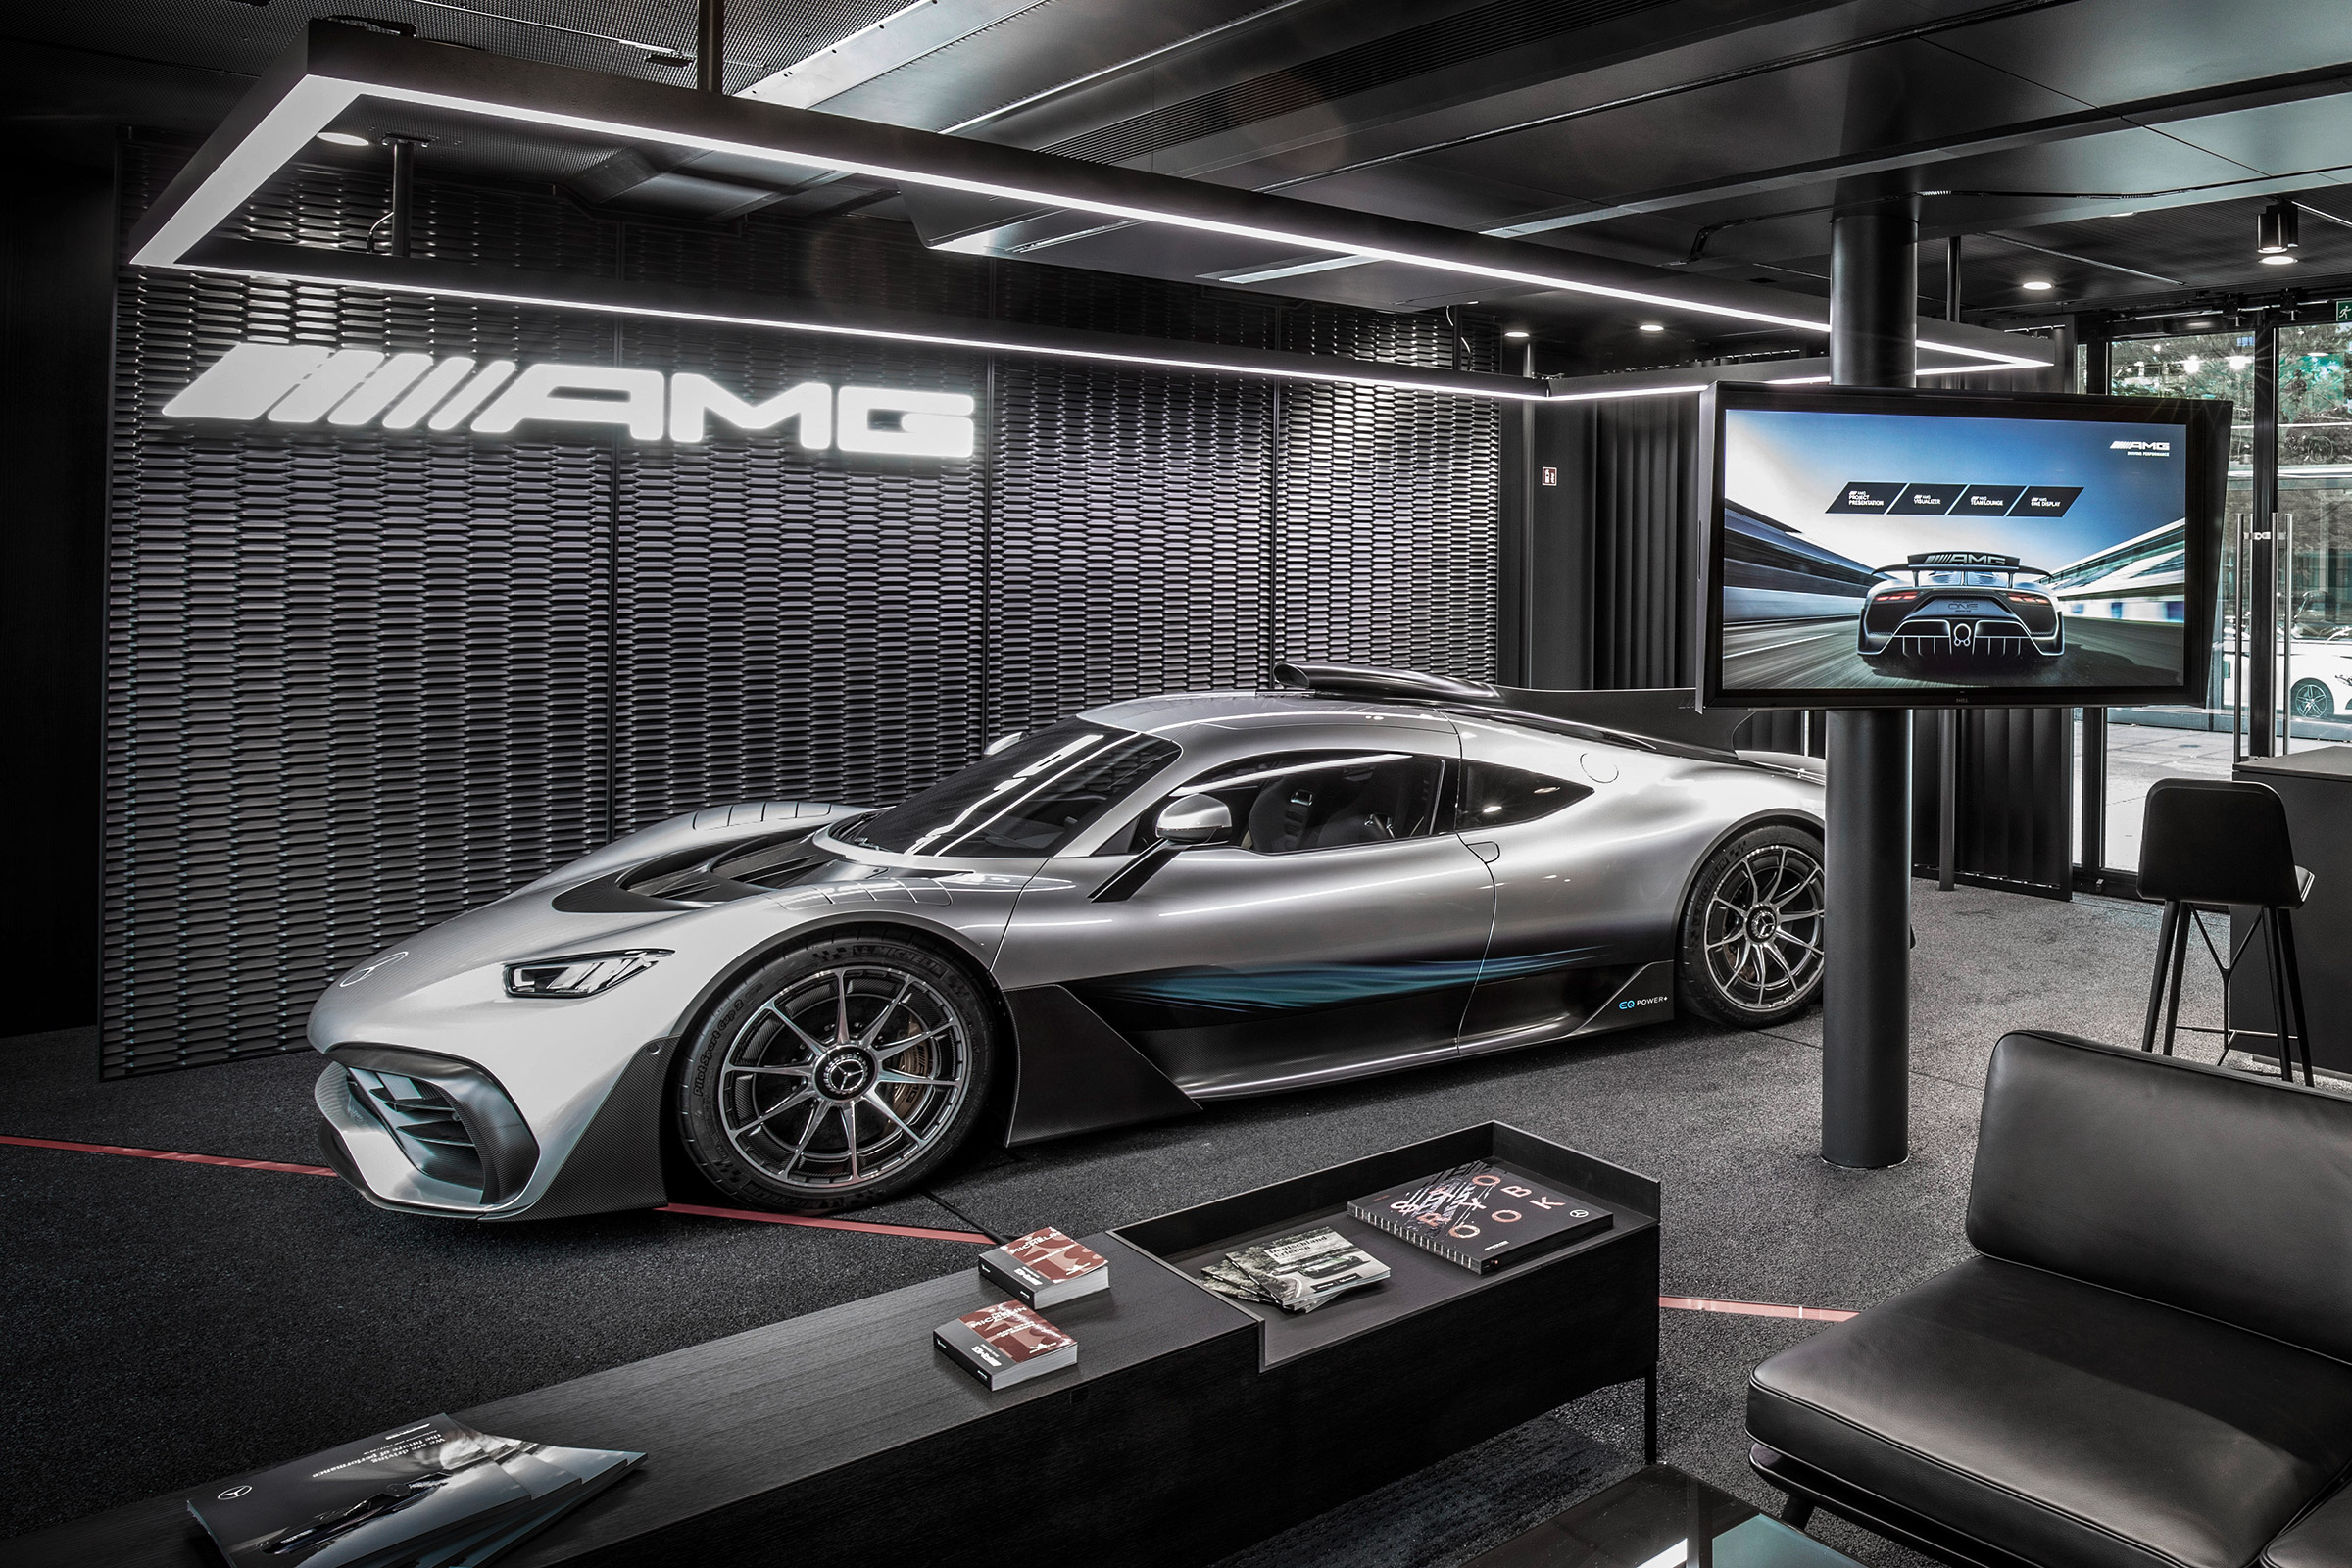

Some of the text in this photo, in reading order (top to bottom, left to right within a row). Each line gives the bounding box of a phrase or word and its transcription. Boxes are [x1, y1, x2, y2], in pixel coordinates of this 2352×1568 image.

[470, 362, 976, 459] AMG
[2129, 441, 2170, 451] AMG
[1947, 554, 2007, 565] AMG
[872, 945, 950, 978] MICHELIN
[1618, 996, 1668, 1010] EQ POWER+
[694, 998, 746, 1097] Pilot Sport Cup 2
[1269, 1235, 1328, 1254] Deutschland
[393, 1440, 423, 1451] future
[370, 1448, 409, 1463] driving
[312, 1453, 378, 1478] performance
